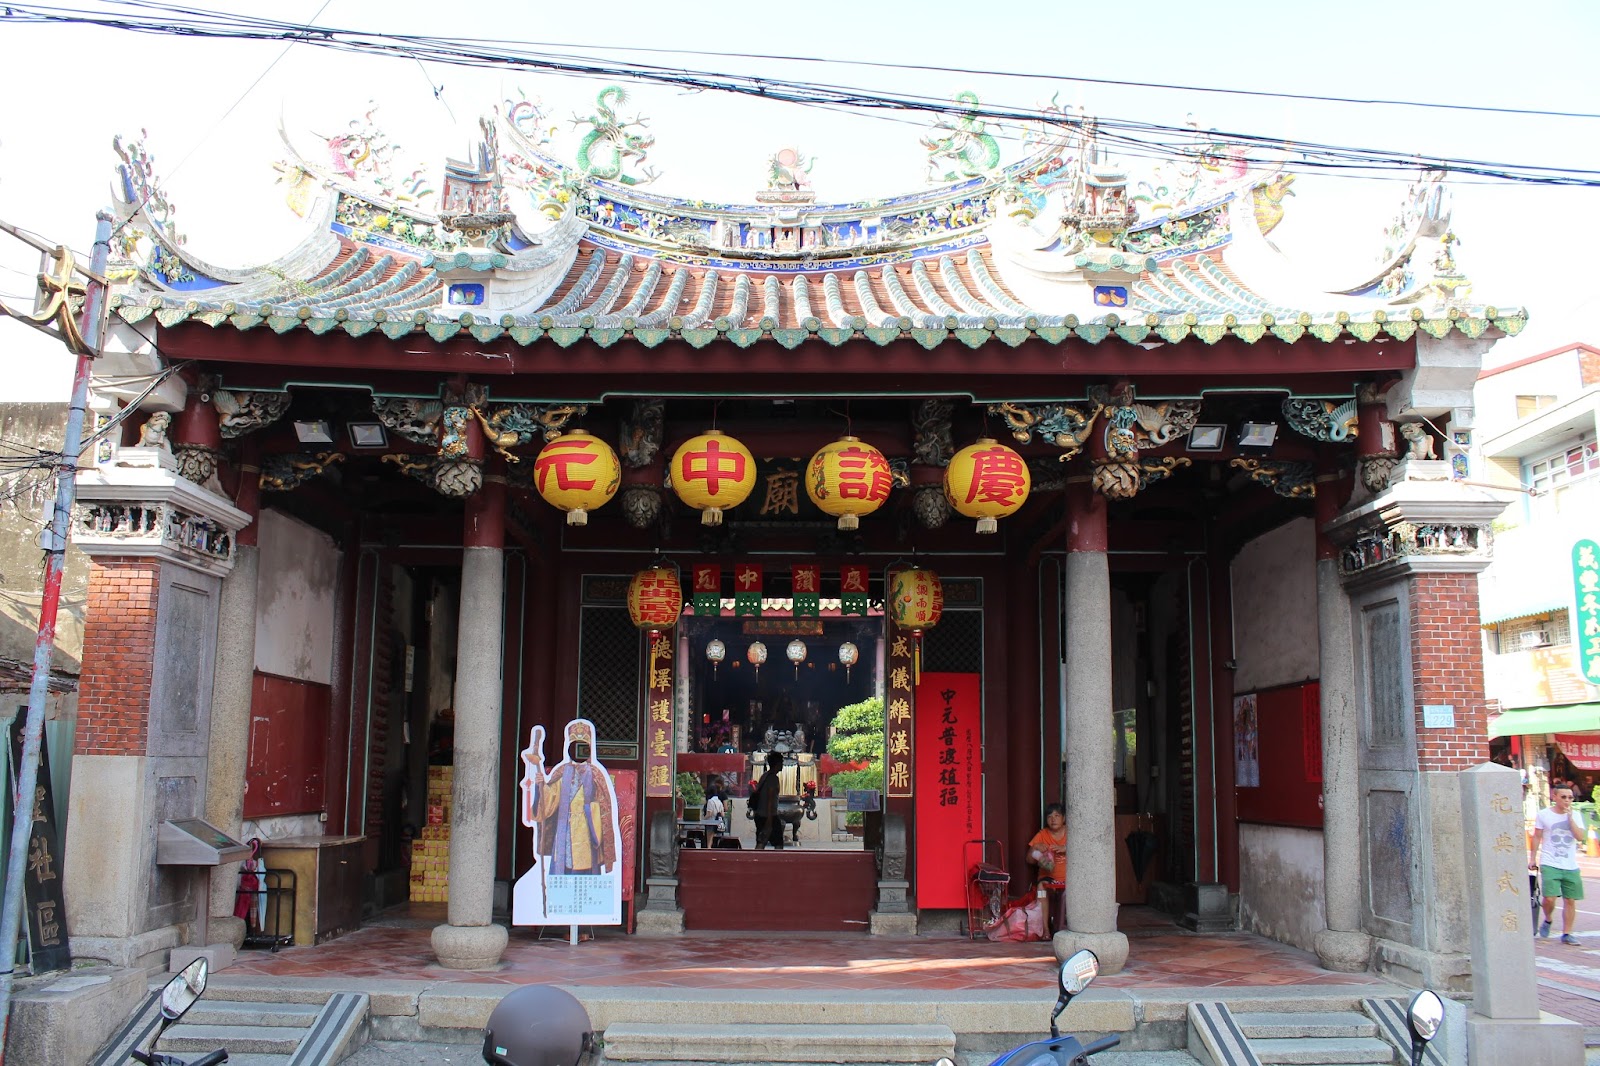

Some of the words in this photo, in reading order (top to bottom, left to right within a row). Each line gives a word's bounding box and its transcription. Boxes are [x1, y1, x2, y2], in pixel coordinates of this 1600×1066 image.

[535, 440, 599, 495] 元
[682, 440, 745, 496] 中
[760, 466, 799, 515] 廟
[964, 446, 1026, 507] 慶
[738, 566, 758, 590] 中
[938, 688, 960, 807] 中元普渡植福
[1432, 715, 1452, 726] 229
[1490, 793, 1519, 932] 祀典武廟
